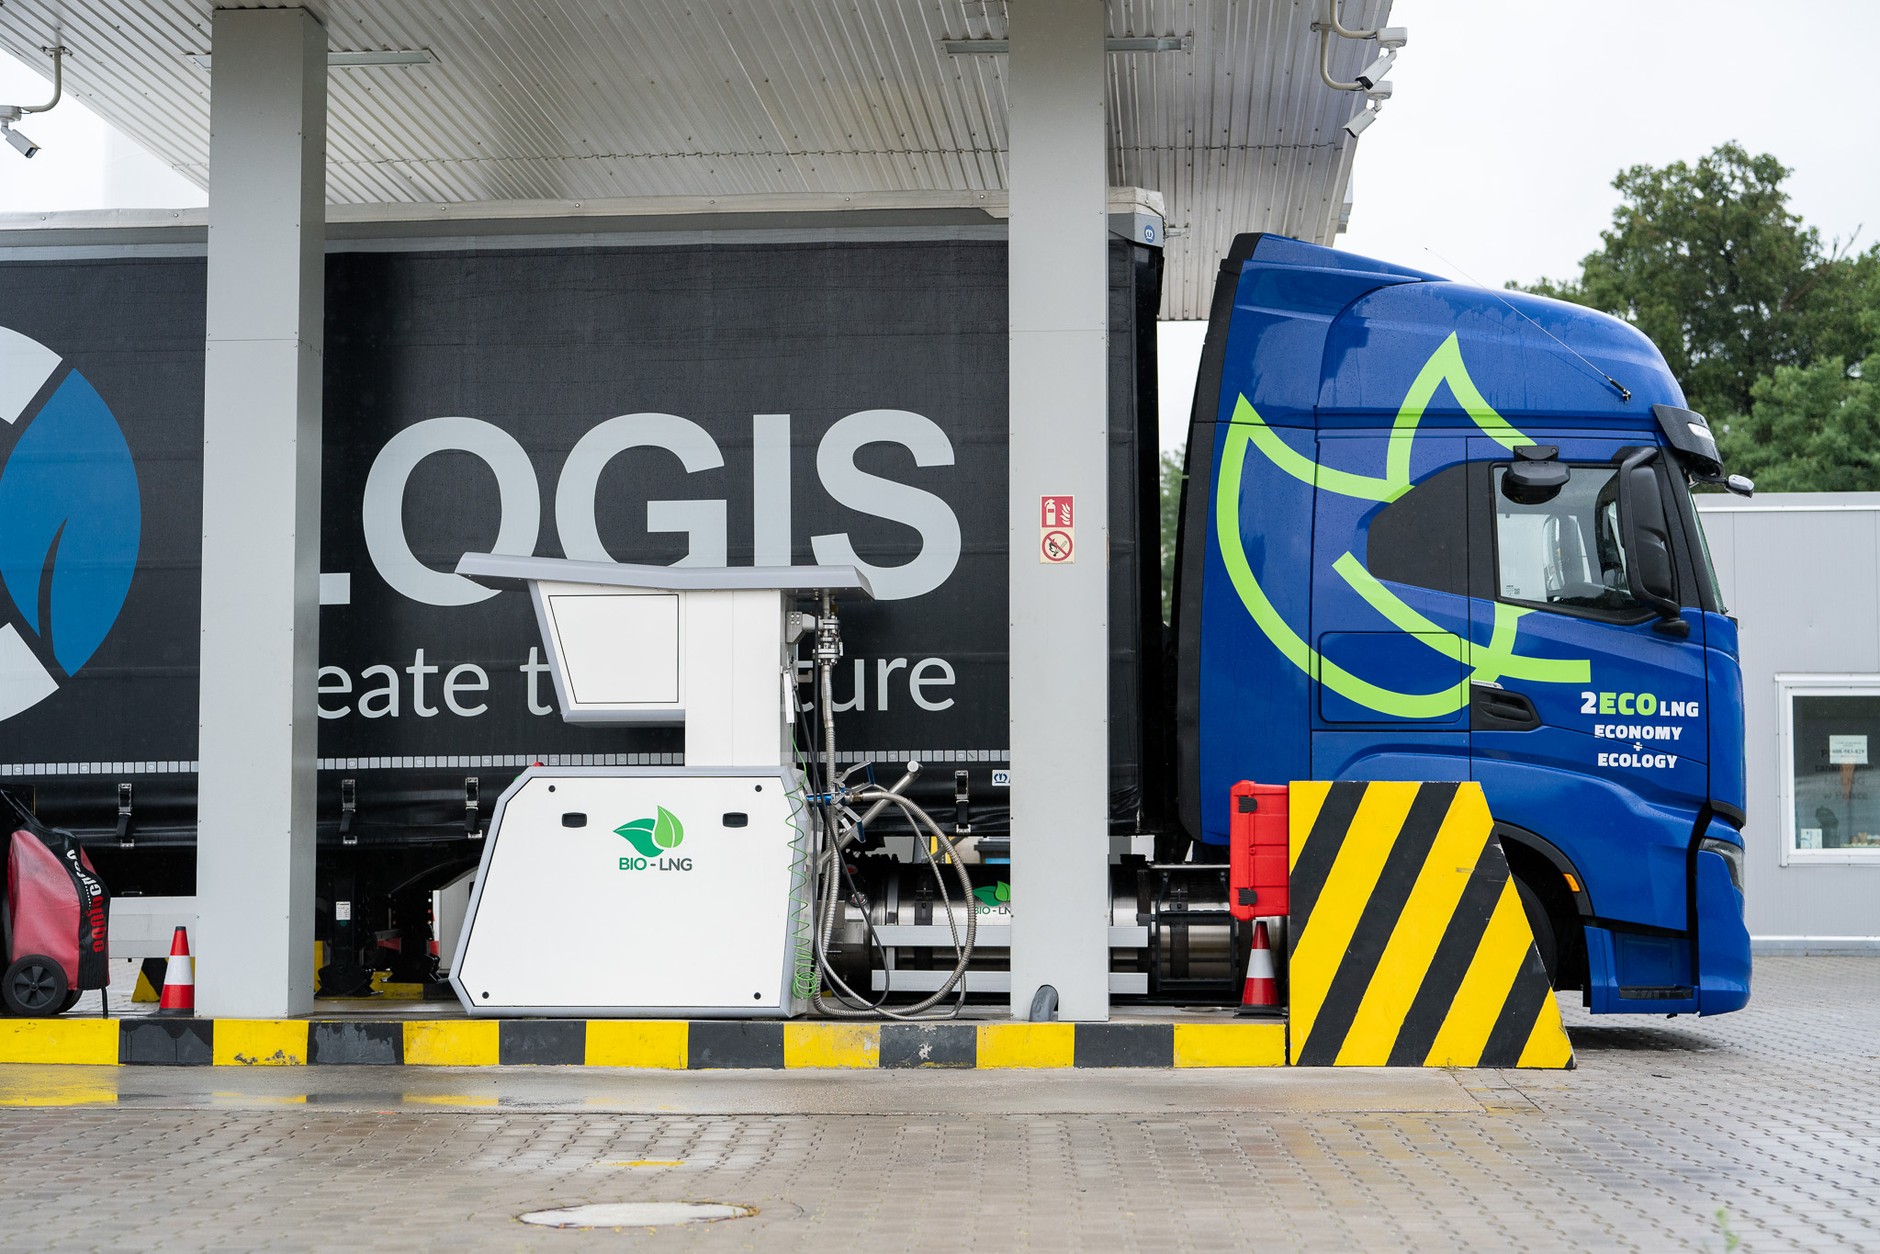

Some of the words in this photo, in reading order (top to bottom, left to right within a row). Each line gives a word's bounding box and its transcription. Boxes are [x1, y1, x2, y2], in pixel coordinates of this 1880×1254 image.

[320, 409, 961, 606] OGIS
[318, 648, 490, 720] eate
[1580, 691, 1657, 716] 2ECO
[1660, 701, 1699, 717] LNG
[1594, 724, 1683, 740] ECONOMY
[1597, 753, 1678, 769] ECOLOGY
[619, 857, 648, 871] BIO
[659, 857, 693, 872] LNG
[998, 906, 1011, 915] LN
